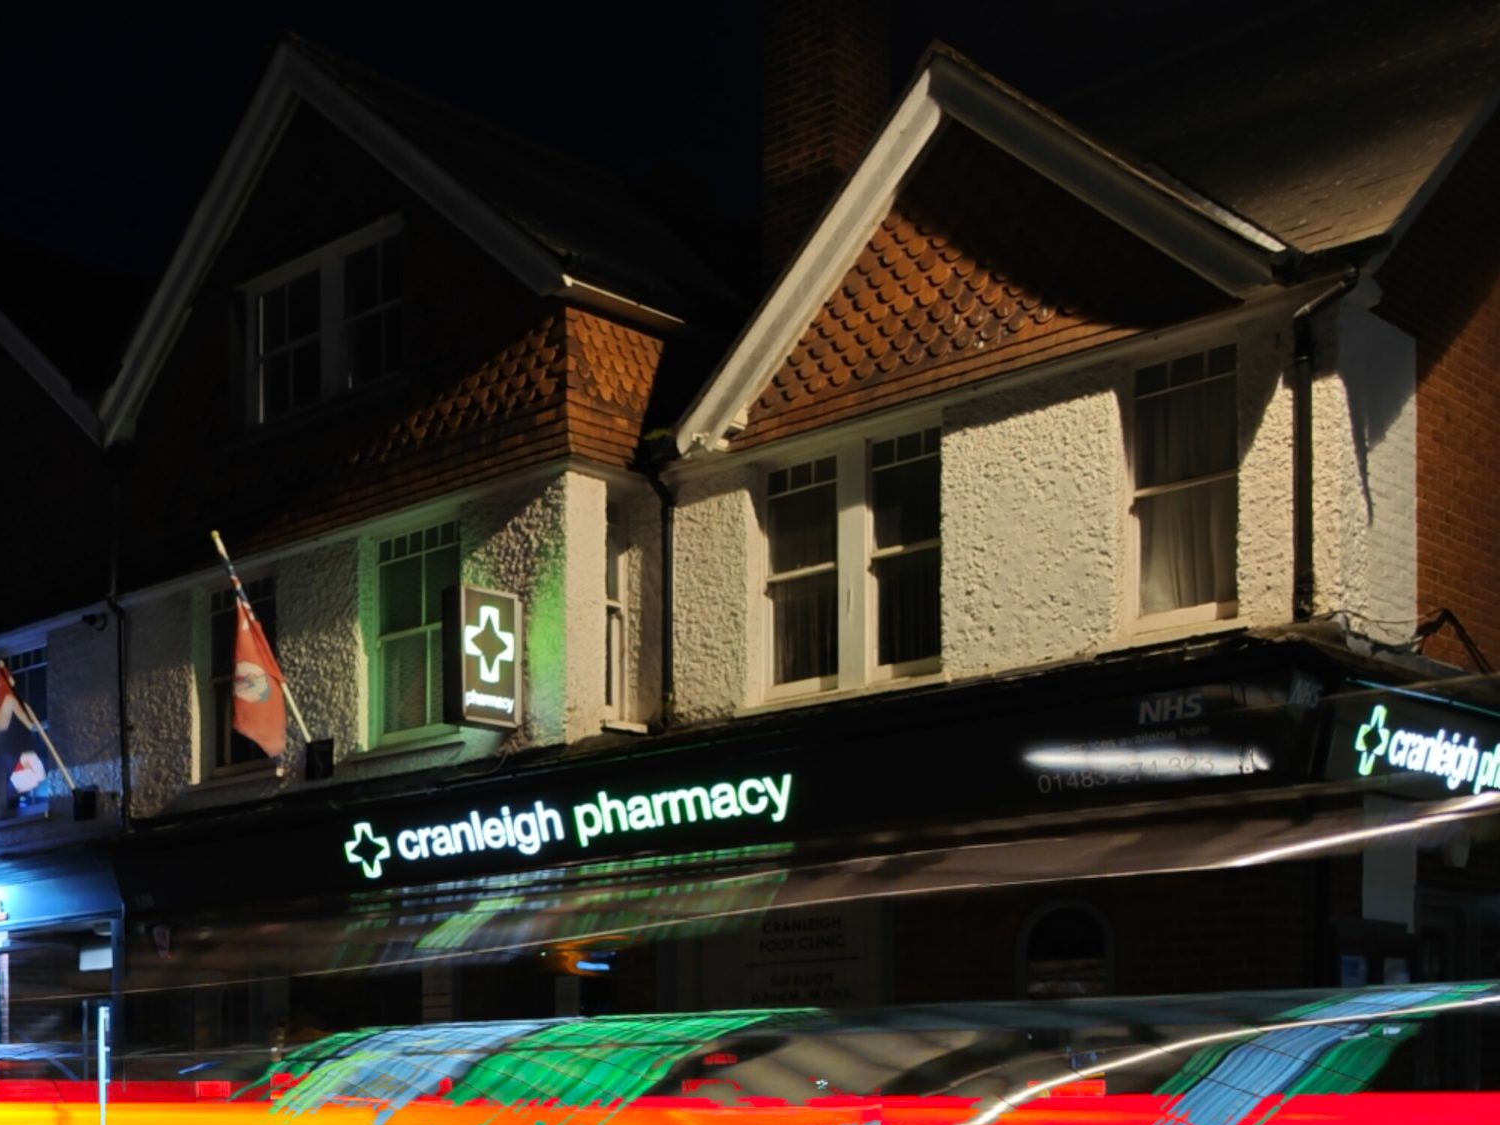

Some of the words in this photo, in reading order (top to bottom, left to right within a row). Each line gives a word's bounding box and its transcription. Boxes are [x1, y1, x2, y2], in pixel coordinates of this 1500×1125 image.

[1137, 693, 1204, 725] NHS
[1119, 729, 1177, 747] available
[1180, 722, 1211, 738] here
[1037, 768, 1109, 794] 01483
[1168, 754, 1215, 778] 323
[1388, 729, 1479, 790] cranleigh
[397, 801, 564, 856] cranleigh
[573, 773, 792, 847] pharmacy
[762, 916, 842, 934] CRANLEIGH
[759, 938, 795, 953] FOOT
[798, 934, 845, 950] CLINIC
